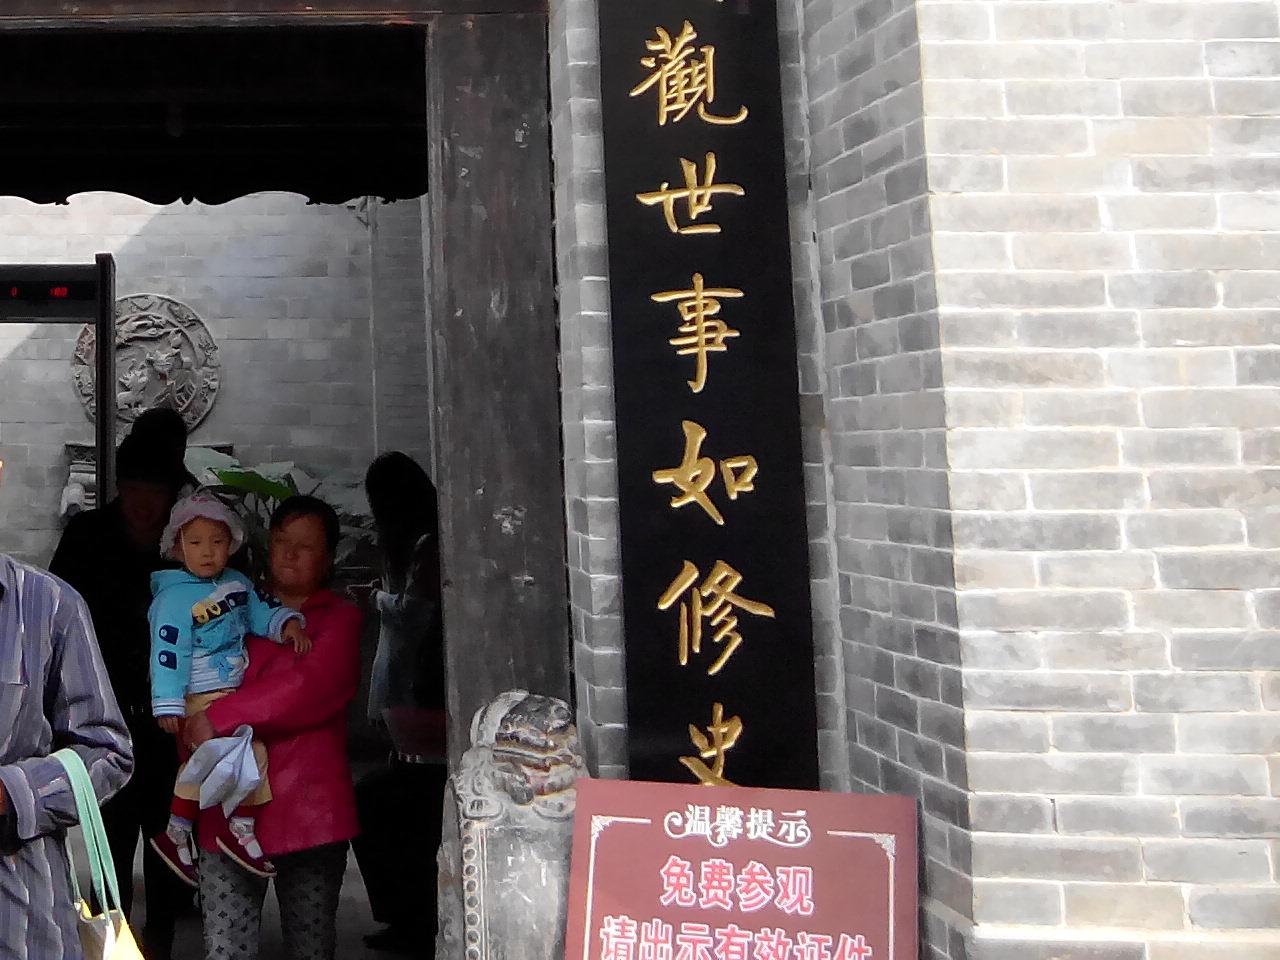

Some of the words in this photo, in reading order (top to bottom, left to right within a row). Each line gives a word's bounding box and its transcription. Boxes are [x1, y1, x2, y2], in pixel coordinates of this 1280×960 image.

[684, 804, 809, 842] 温馨提示
[659, 855, 815, 916] 免费参观
